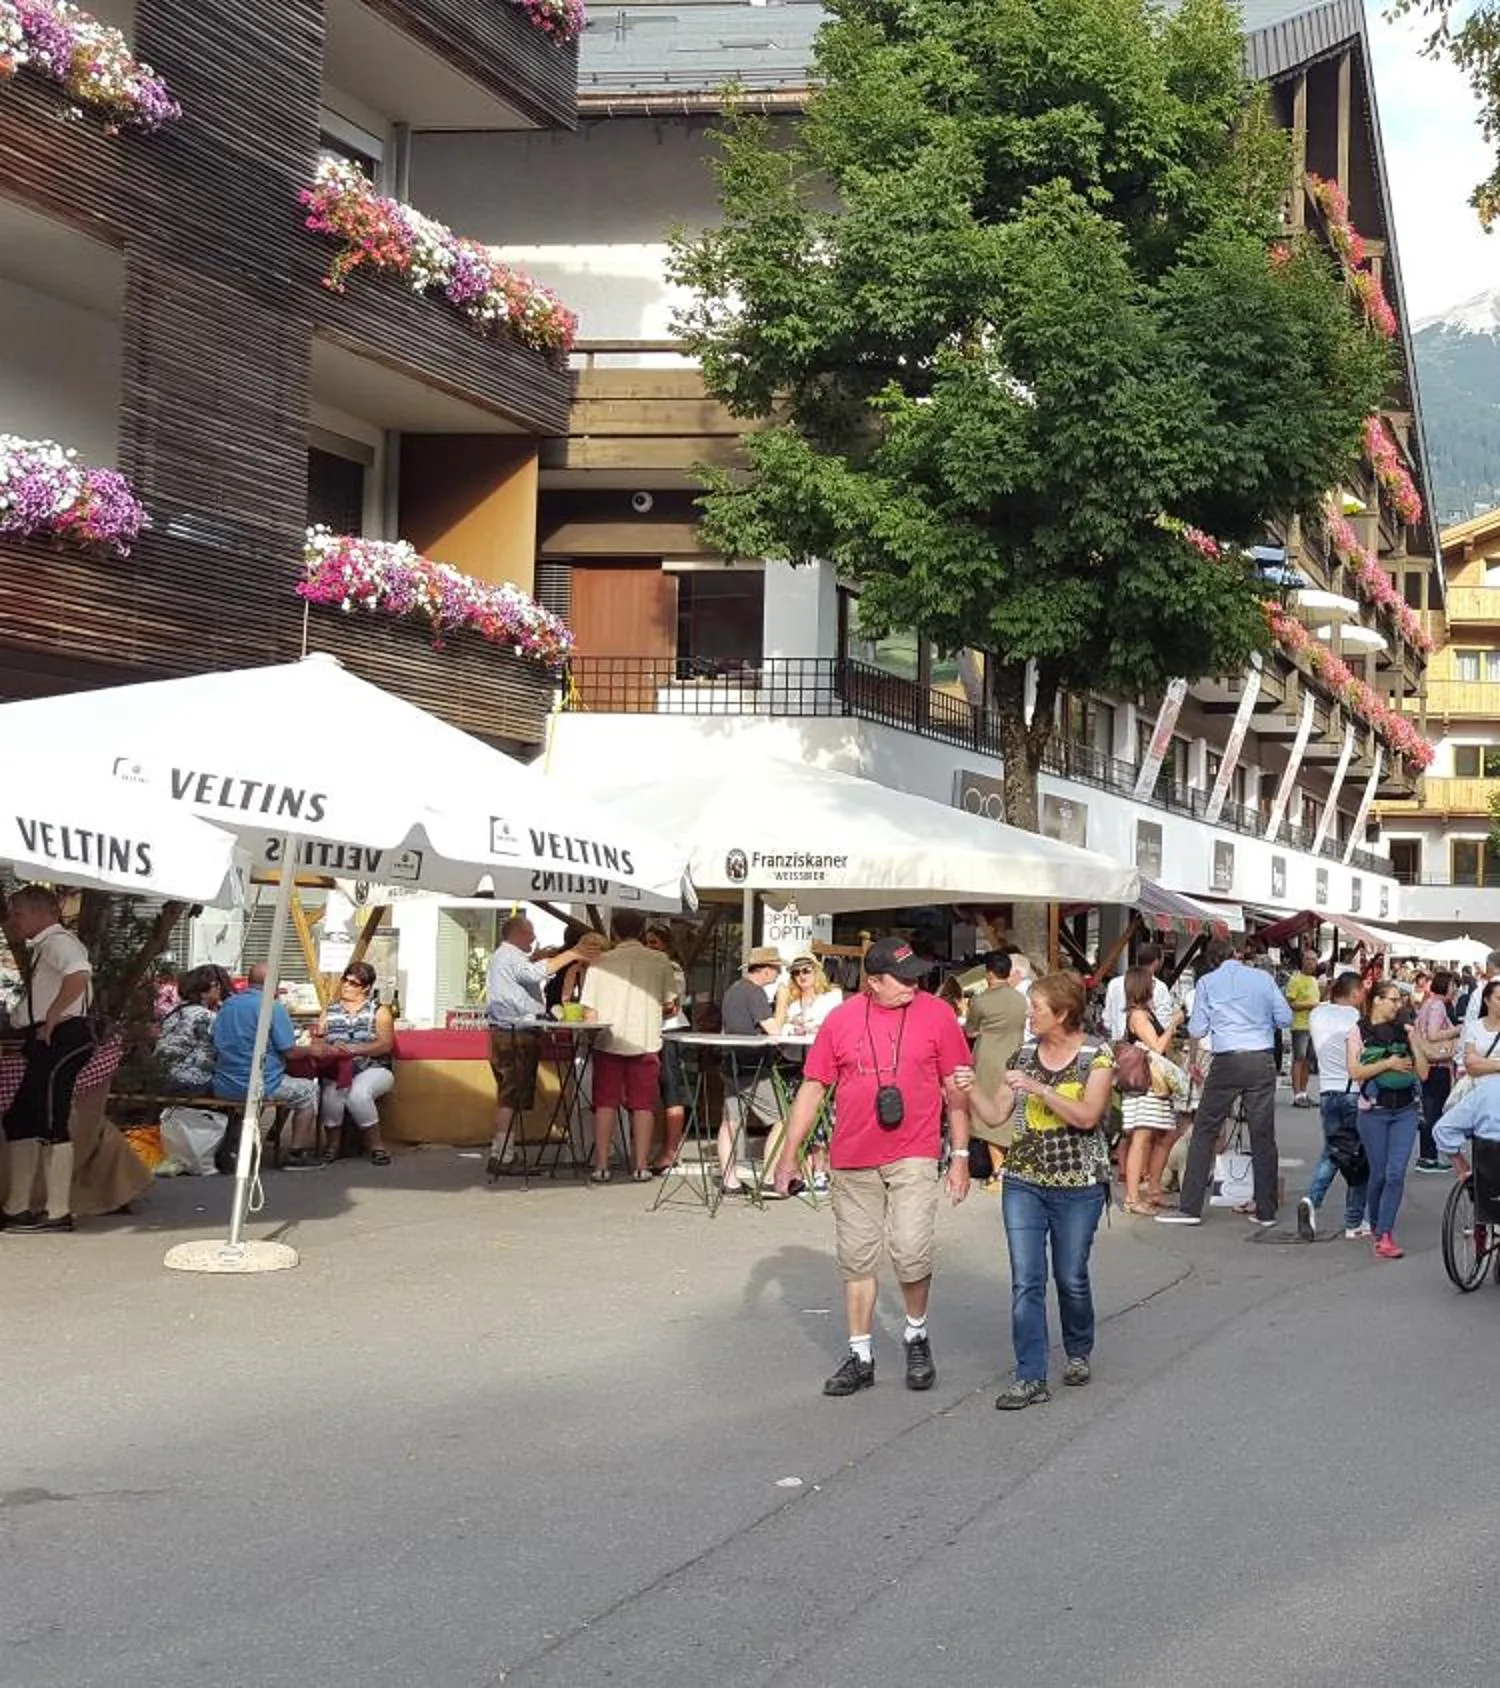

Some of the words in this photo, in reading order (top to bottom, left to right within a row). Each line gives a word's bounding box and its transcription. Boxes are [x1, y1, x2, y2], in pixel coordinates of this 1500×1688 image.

[171, 767, 328, 822] VELTINS
[15, 815, 153, 876] VELTINS
[528, 828, 635, 875] VELTINS
[751, 851, 848, 868] Franziskaner
